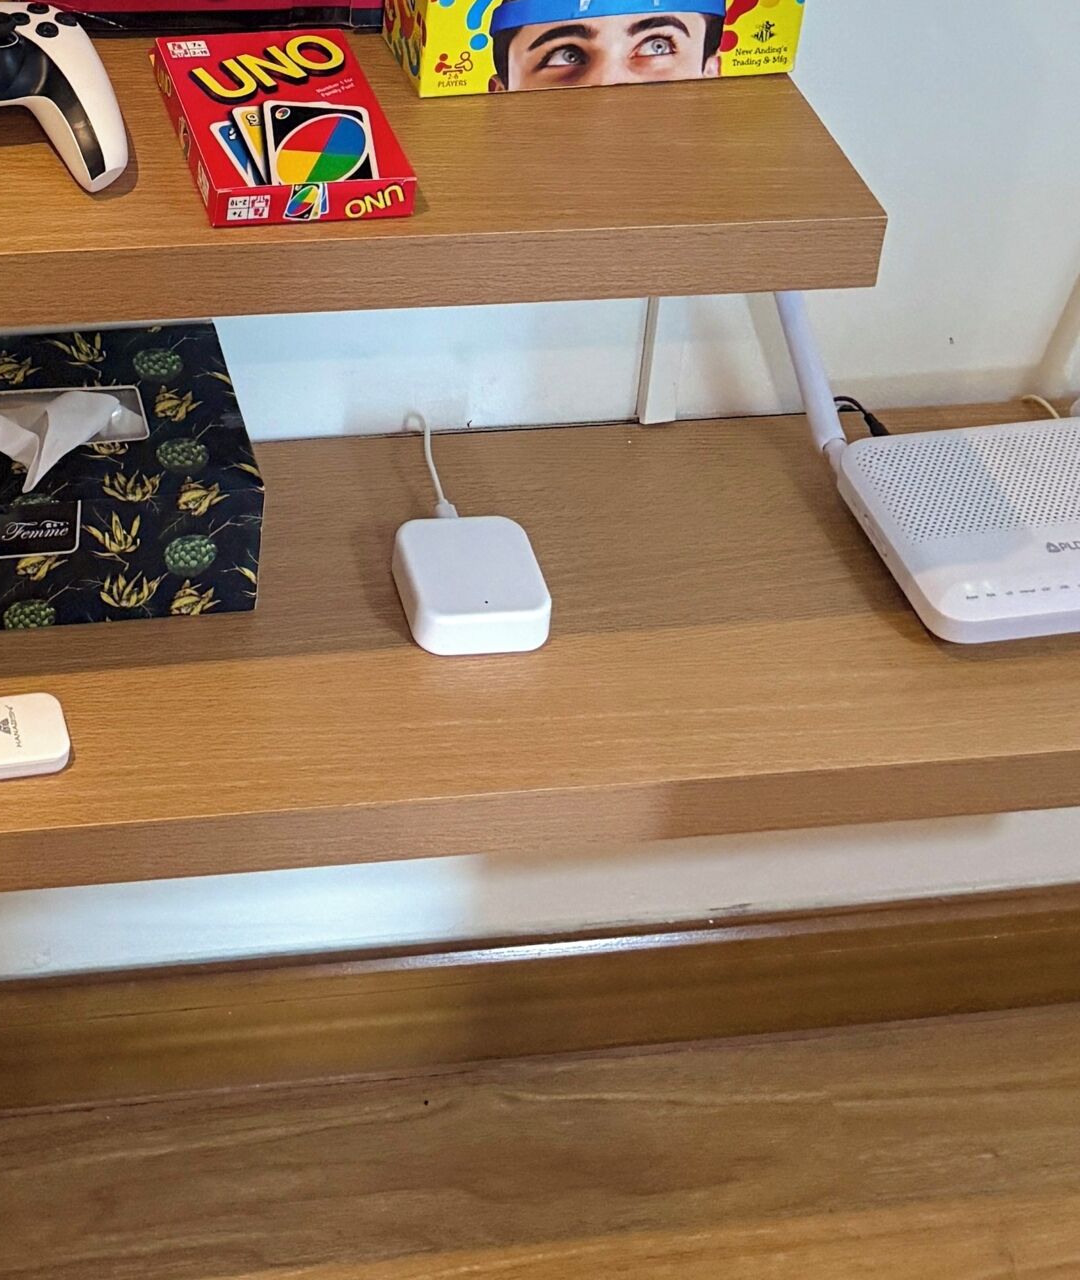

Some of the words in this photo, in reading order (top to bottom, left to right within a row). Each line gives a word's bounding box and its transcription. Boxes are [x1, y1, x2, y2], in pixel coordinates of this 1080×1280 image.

[191, 35, 345, 100] UNO
[732, 58, 761, 67] Trading
[437, 80, 468, 88] PLAYERS
[345, 184, 406, 218] UNO
[1, 519, 70, 542] Femme
